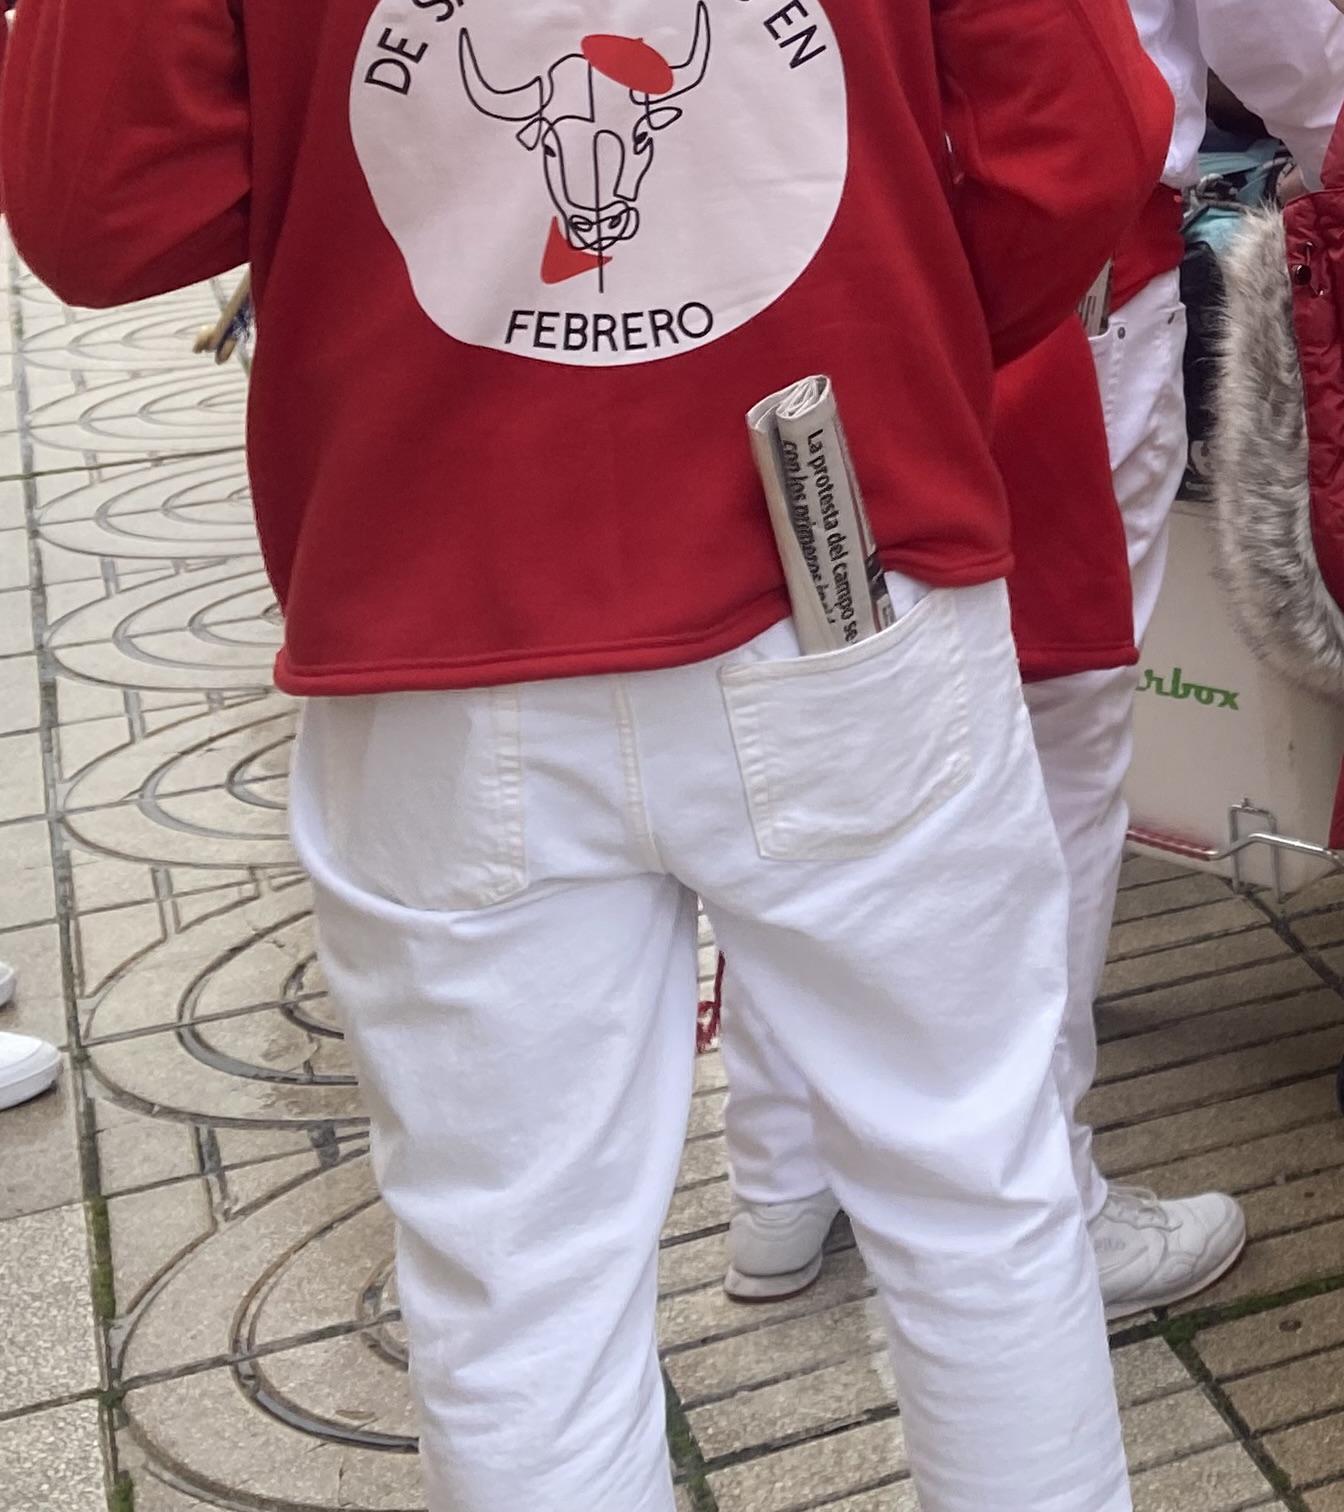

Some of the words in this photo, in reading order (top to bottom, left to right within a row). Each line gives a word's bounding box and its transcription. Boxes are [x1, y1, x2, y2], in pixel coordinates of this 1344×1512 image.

[364, 28, 427, 95] DE
[504, 301, 714, 352] FEBRERO
[807, 428, 824, 455] La
[807, 454, 840, 531] protesta
[826, 532, 850, 562] del
[832, 562, 855, 621] campo
[1136, 667, 1240, 711] rbox
